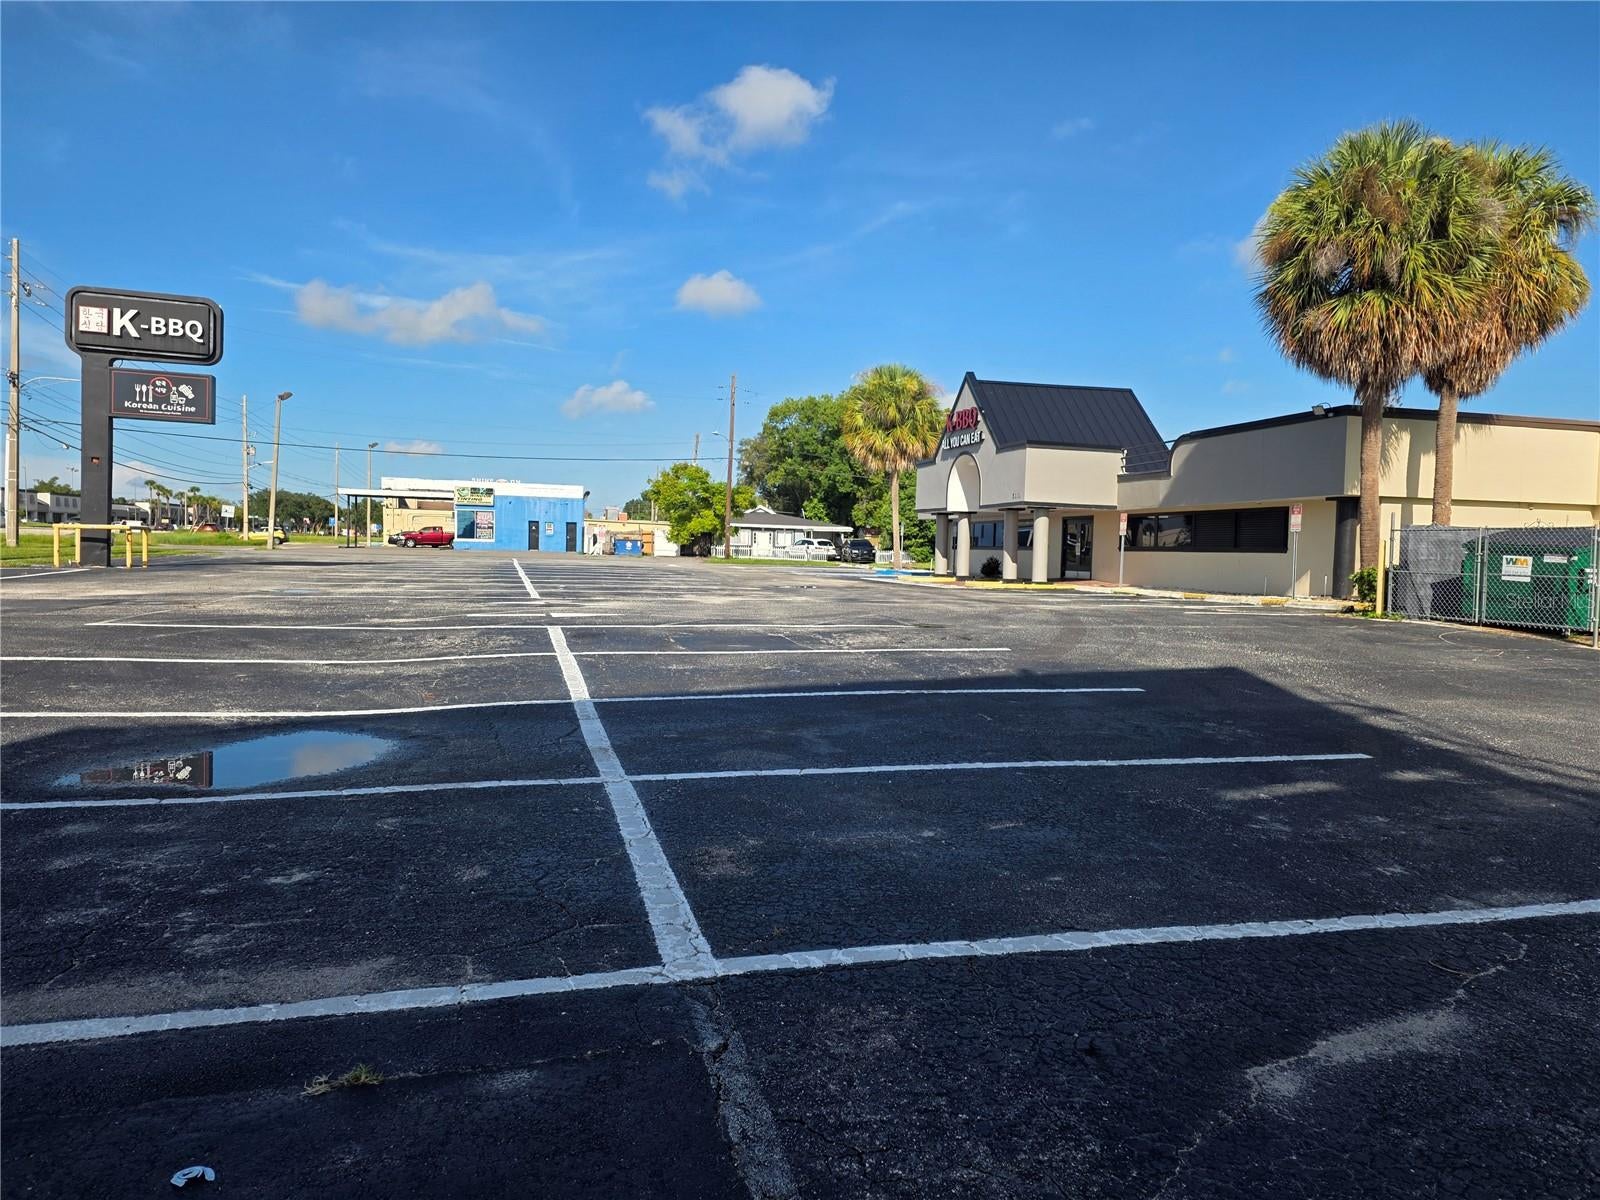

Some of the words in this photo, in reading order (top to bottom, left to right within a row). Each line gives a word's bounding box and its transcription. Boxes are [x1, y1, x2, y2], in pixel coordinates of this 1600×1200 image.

[112, 307, 204, 343] K-BBQ
[124, 400, 159, 410] Korean
[161, 403, 196, 412] Cuisine
[945, 407, 978, 432] K-BBQ
[942, 438, 950, 449] ALL
[950, 436, 959, 448] YOU
[960, 433, 970, 445] CAN
[970, 431, 980, 444] EAT
[1505, 557, 1529, 566] WM
